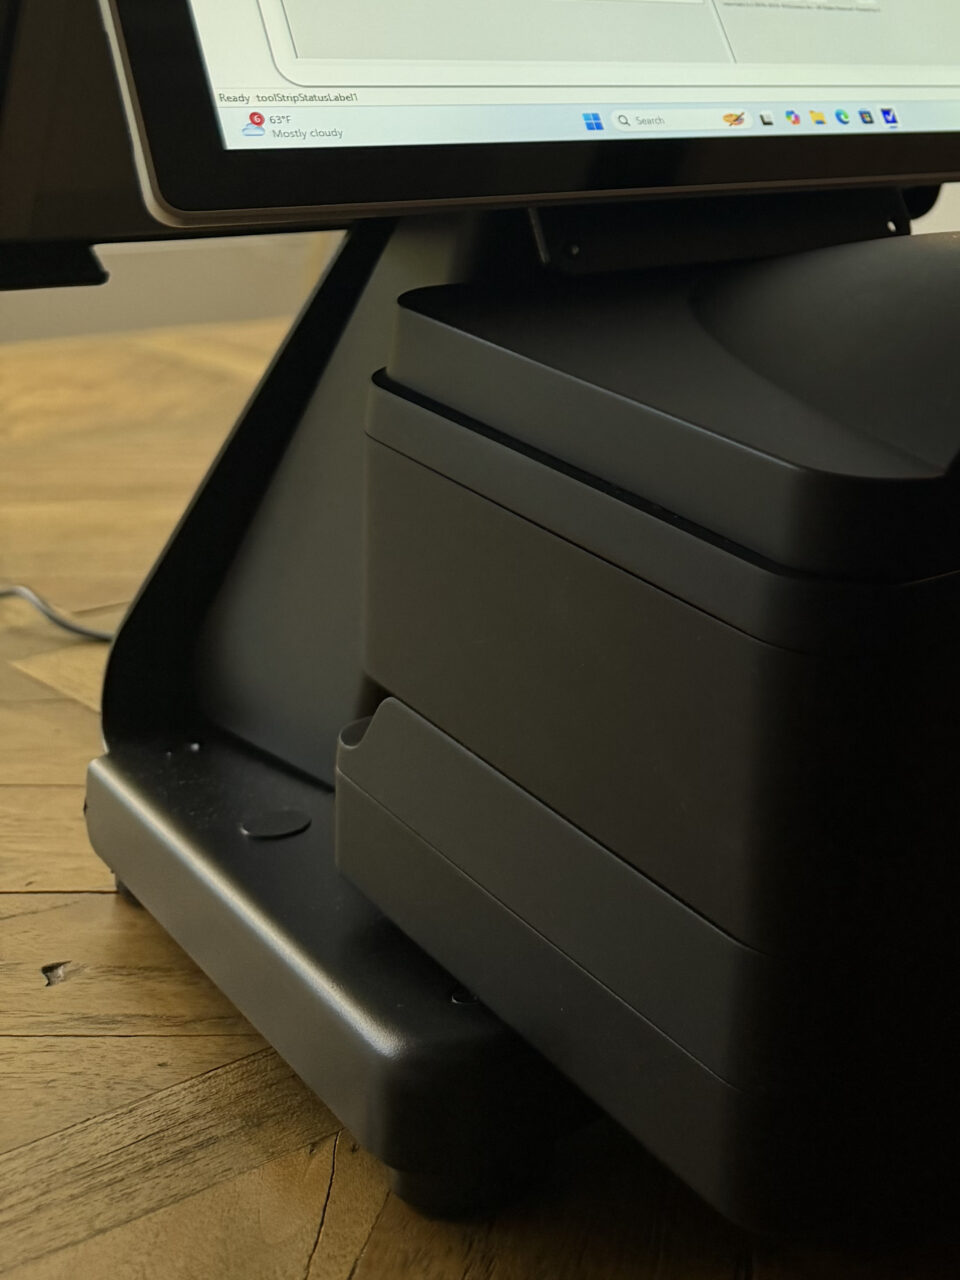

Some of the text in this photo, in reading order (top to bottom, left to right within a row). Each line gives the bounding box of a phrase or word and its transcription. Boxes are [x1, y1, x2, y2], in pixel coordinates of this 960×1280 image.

[219, 93, 358, 105] Ready toolStripStatusLabel1
[269, 115, 292, 125] 63°F
[635, 114, 665, 126] Search
[272, 128, 343, 140] Mostly cloudy
